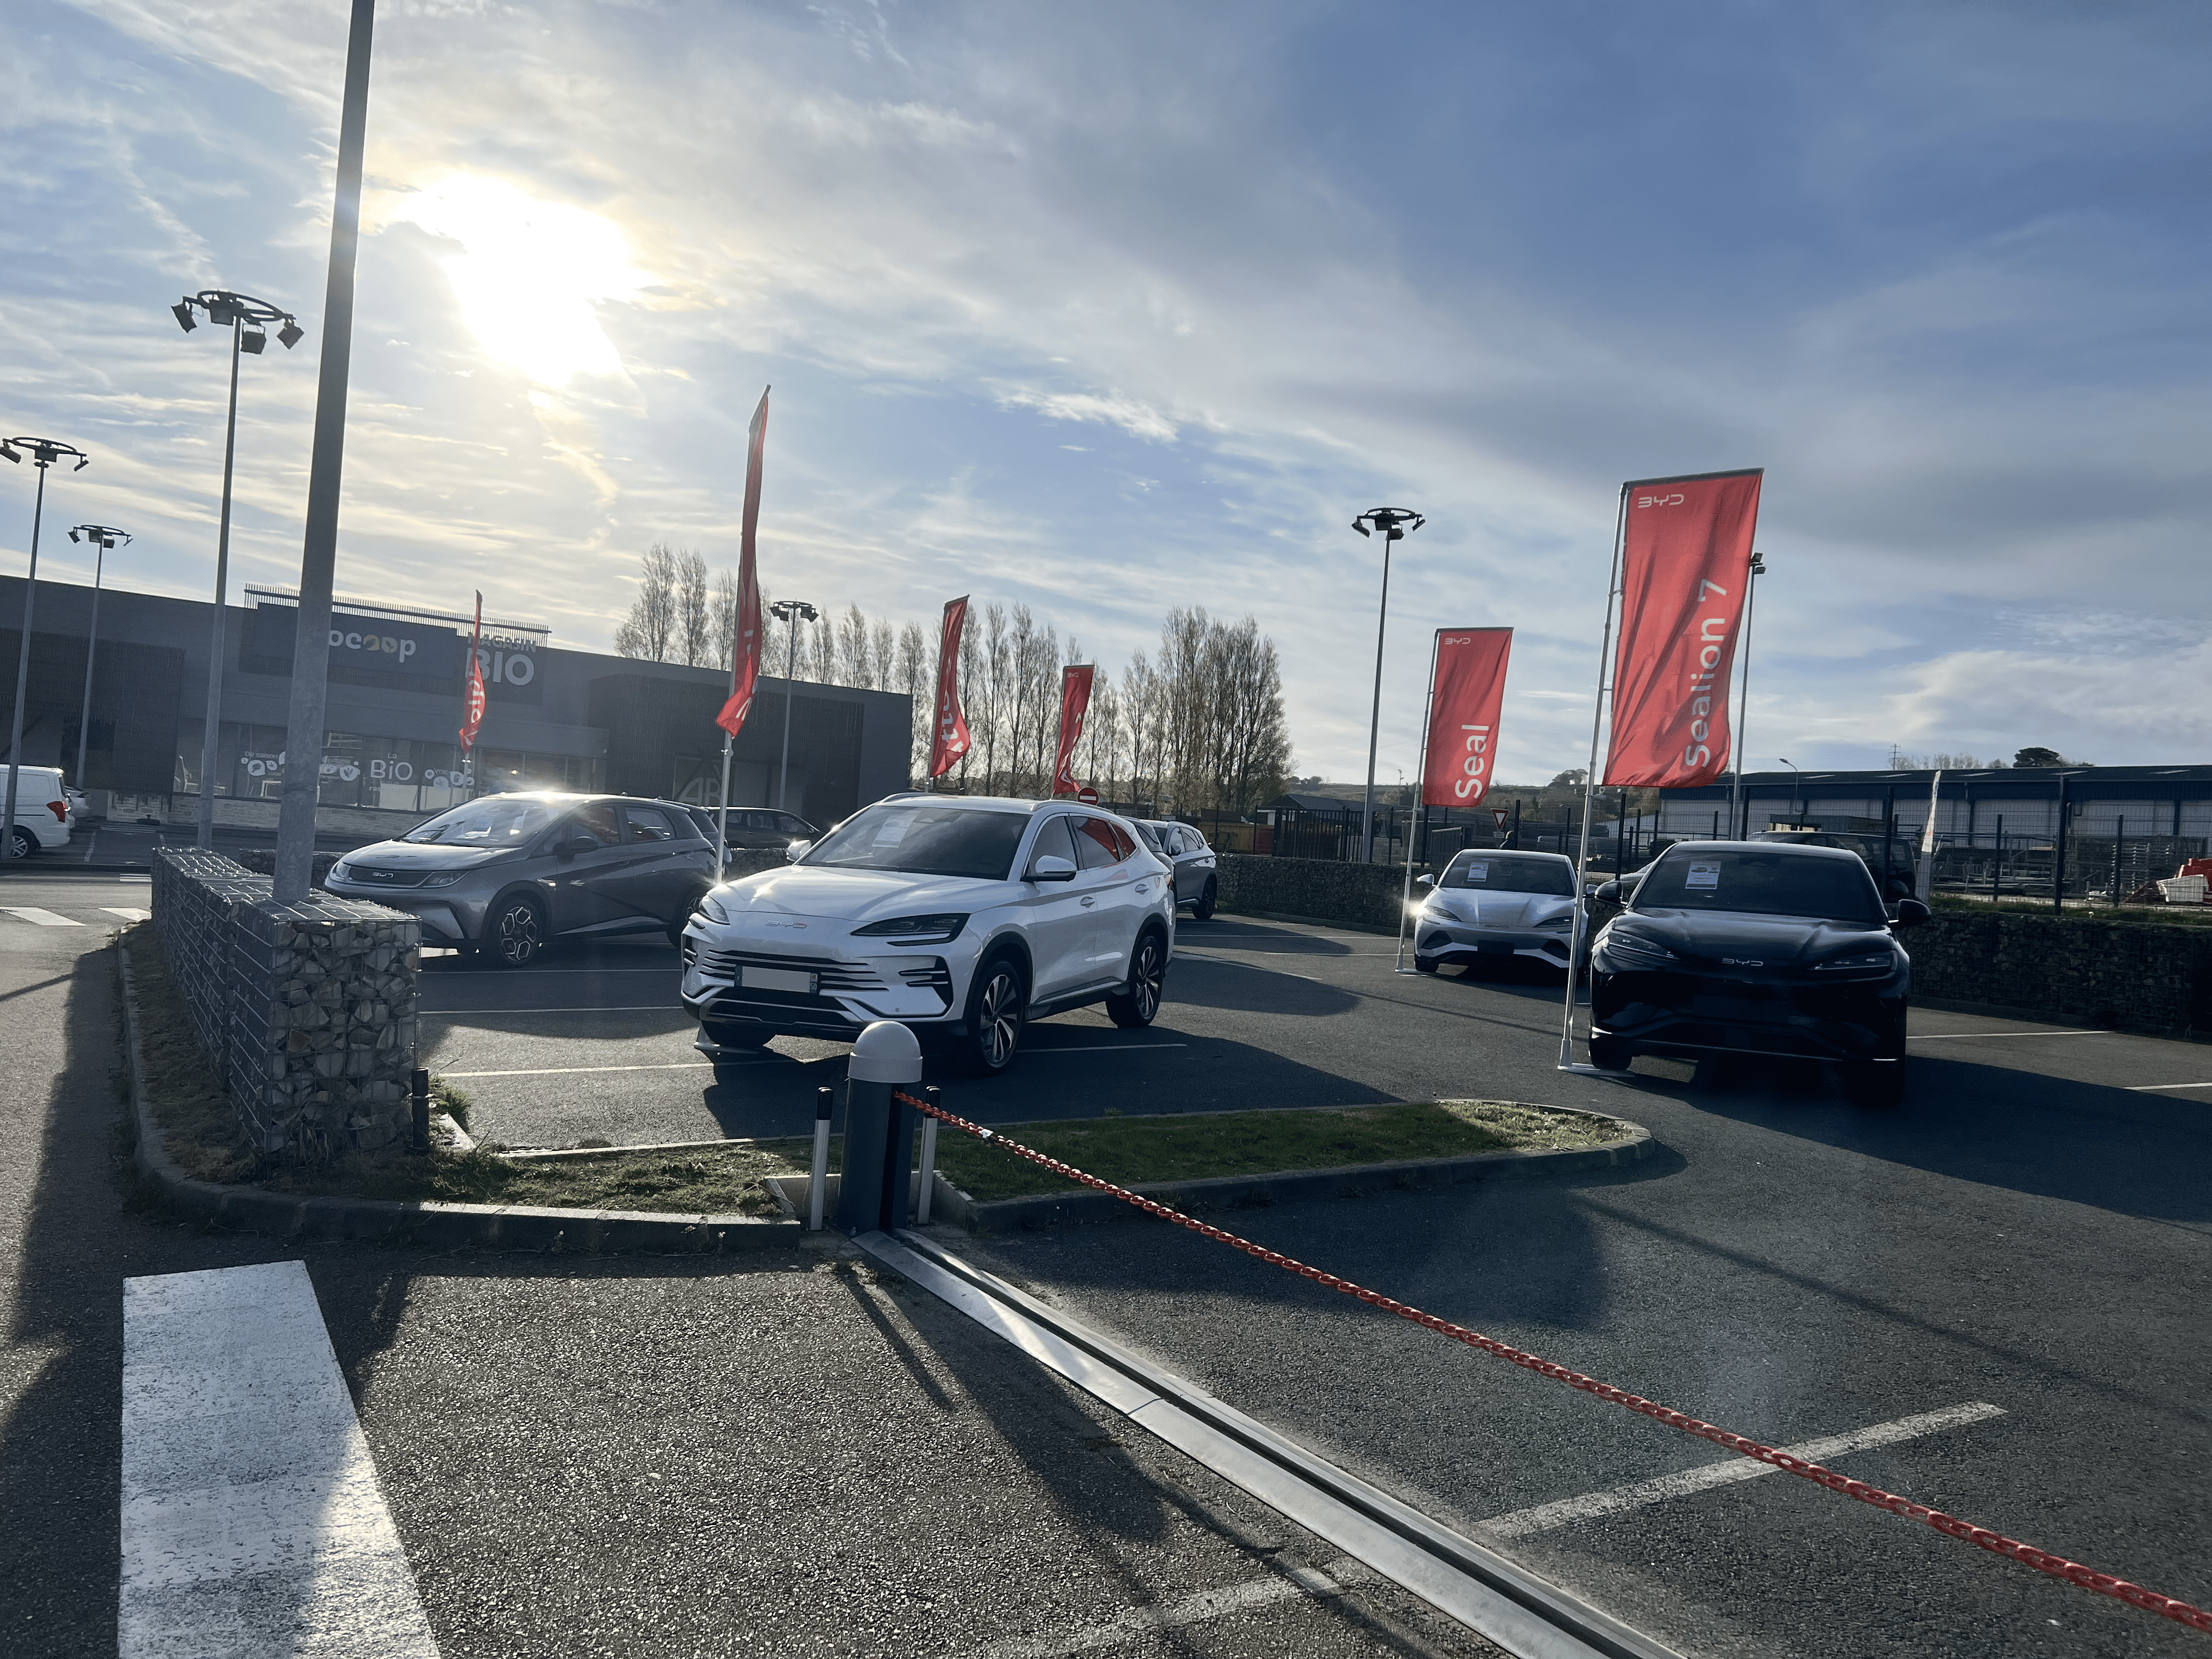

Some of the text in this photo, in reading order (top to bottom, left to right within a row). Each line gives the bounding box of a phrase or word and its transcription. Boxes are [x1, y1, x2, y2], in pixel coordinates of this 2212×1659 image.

[1638, 494, 1684, 509] BYD
[329, 630, 416, 663] ocoop
[465, 647, 535, 686] BIO
[1684, 578, 1726, 768] Sealion 7
[1455, 724, 1489, 799] Seal
[765, 920, 808, 929] BYD
[1722, 958, 1764, 966] BYD
